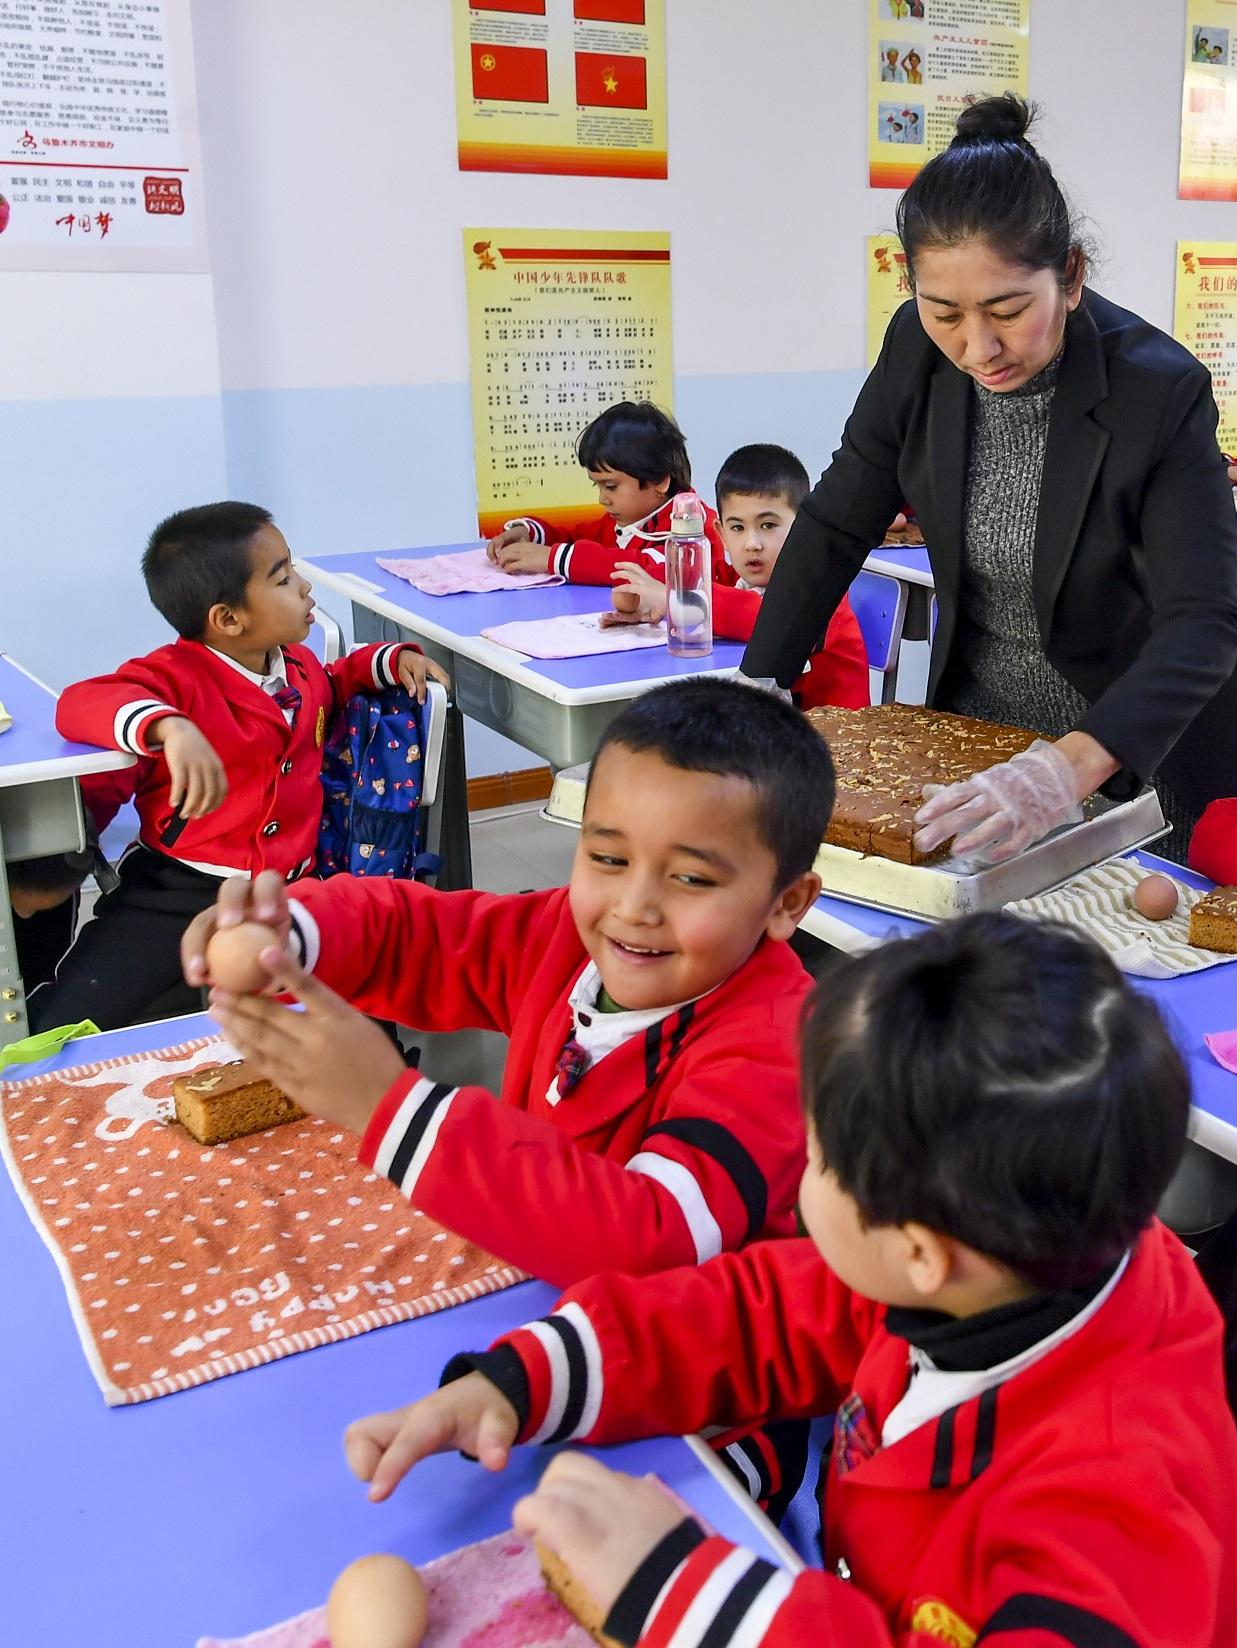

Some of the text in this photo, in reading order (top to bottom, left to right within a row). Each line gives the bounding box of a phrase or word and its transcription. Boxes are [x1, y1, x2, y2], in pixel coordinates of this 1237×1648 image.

[42, 138, 115, 149] 乌鲁木齐市文明办
[56, 211, 113, 239] 中国梦
[513, 271, 627, 285] 中国少年先锋队队歌
